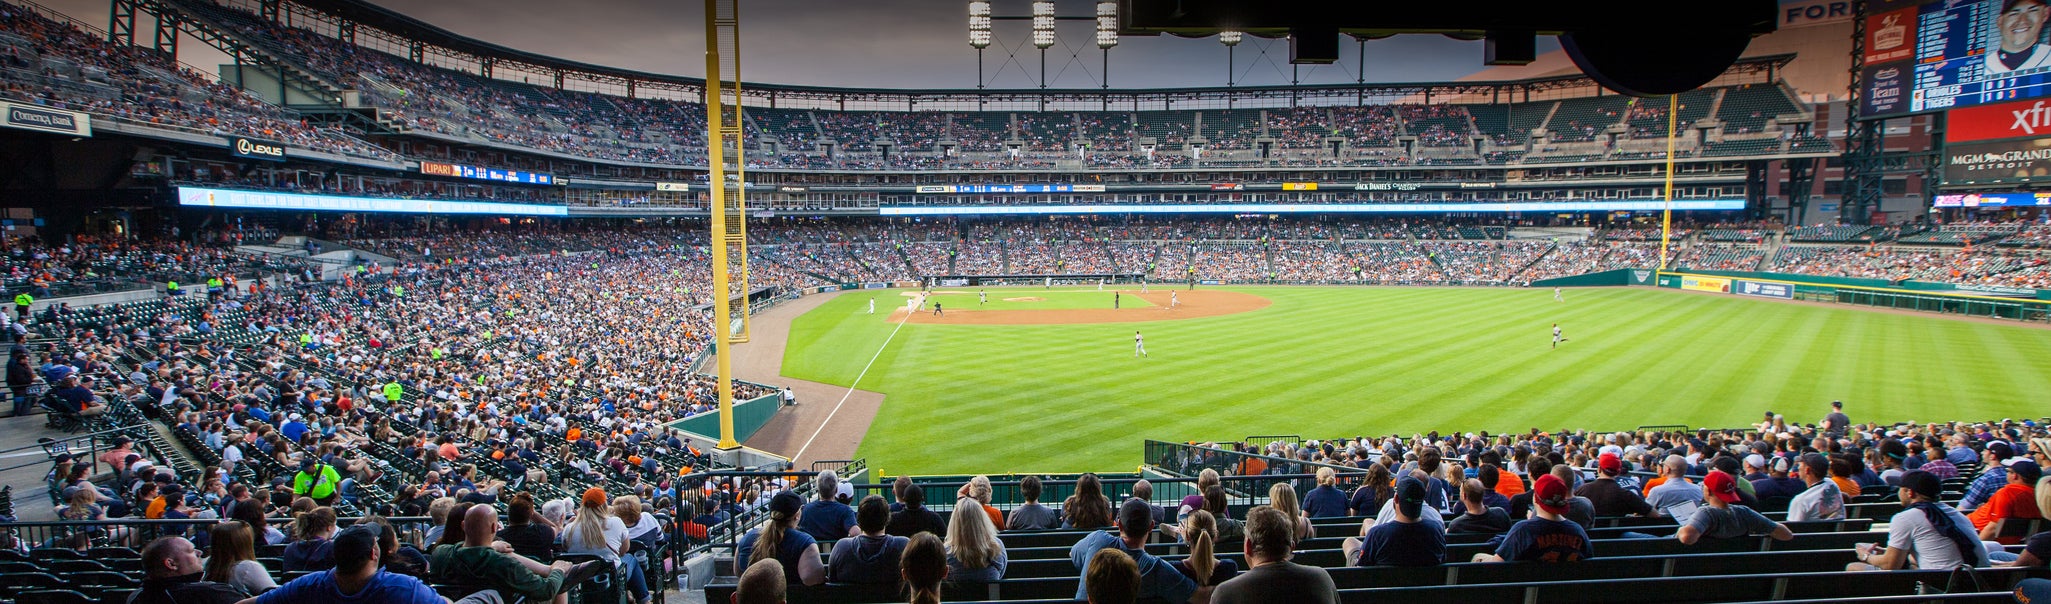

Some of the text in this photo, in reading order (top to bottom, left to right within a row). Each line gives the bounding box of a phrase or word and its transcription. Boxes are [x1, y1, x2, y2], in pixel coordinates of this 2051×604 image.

[1786, 1, 1855, 23] FOR
[1871, 87, 1900, 99] Team
[1926, 85, 1962, 98] ORIOLES
[2009, 77, 2017, 87] 7
[1925, 97, 1956, 109] TIGERS
[2009, 88, 2017, 99] 3
[52, 114, 73, 127] Bank
[250, 143, 283, 157] LEXUS
[1951, 149, 2051, 165] MGM GRAND
[425, 165, 451, 175] LIPARI
[1968, 162, 2033, 171] DETROIT
[1355, 182, 1392, 190] JACK DANIEL'S
[1683, 279, 1699, 287] DMC
